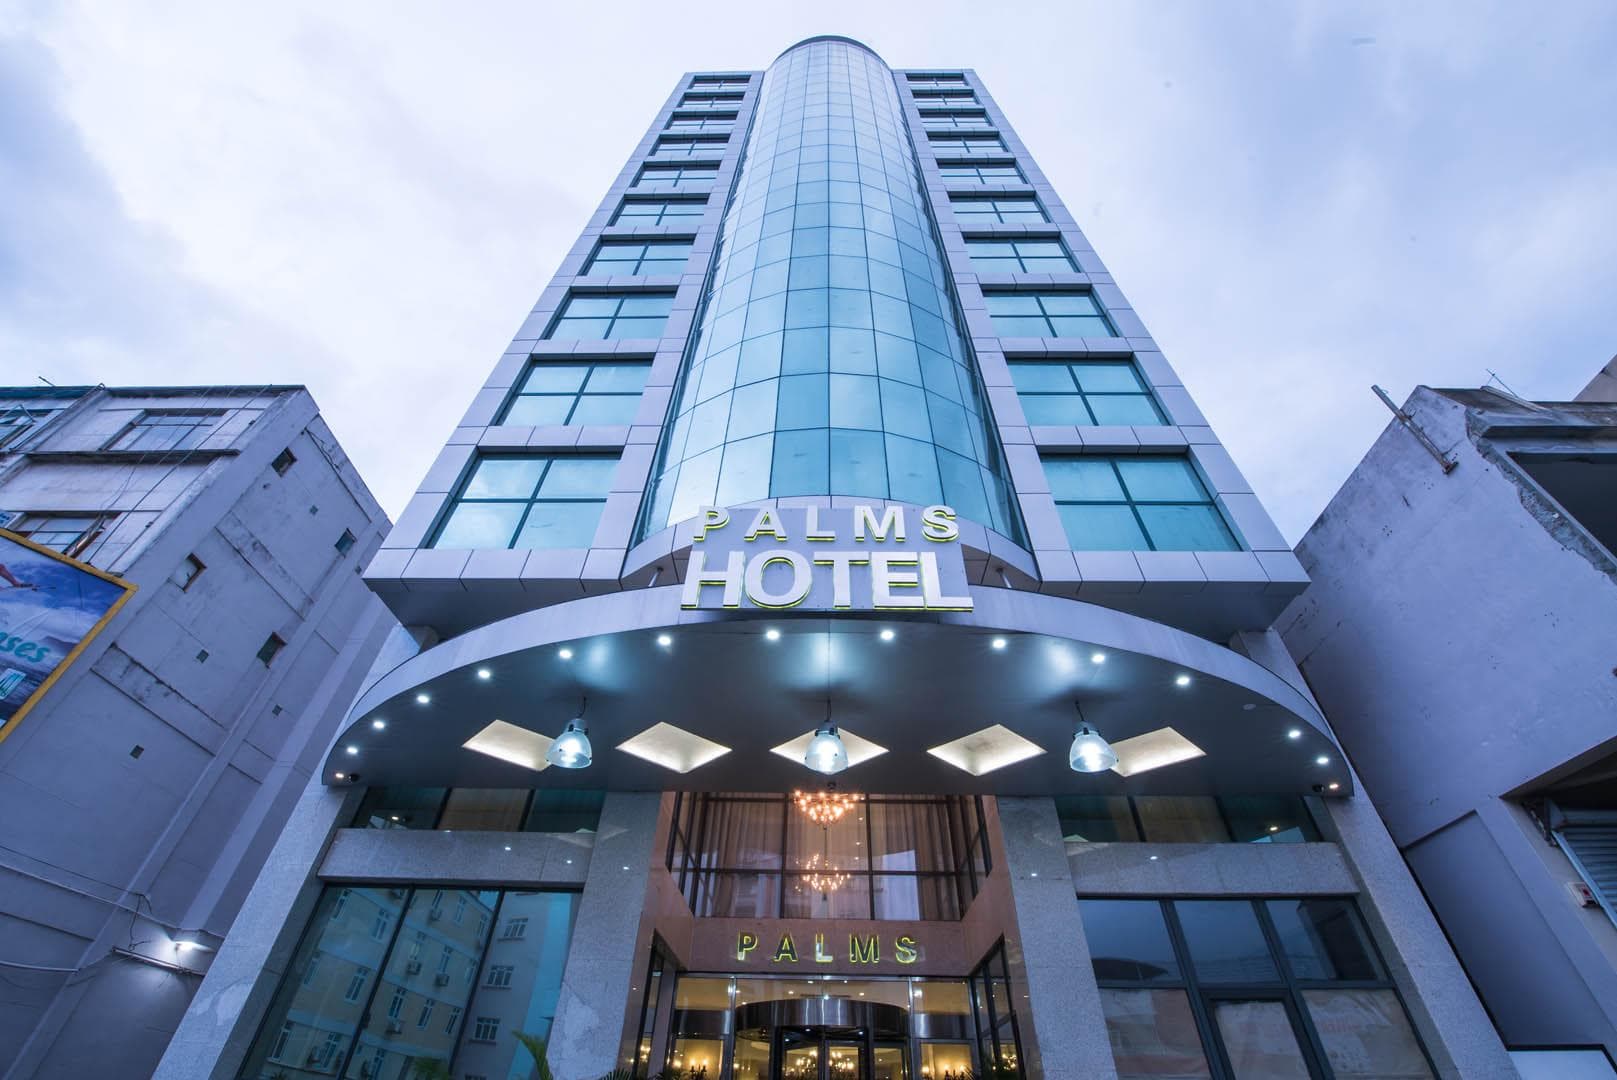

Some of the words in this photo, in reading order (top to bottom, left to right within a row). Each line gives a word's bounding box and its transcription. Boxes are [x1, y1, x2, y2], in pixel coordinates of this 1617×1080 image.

[692, 504, 960, 543] PALMS
[680, 549, 974, 612] HOTEL
[736, 931, 919, 965] PALMS
